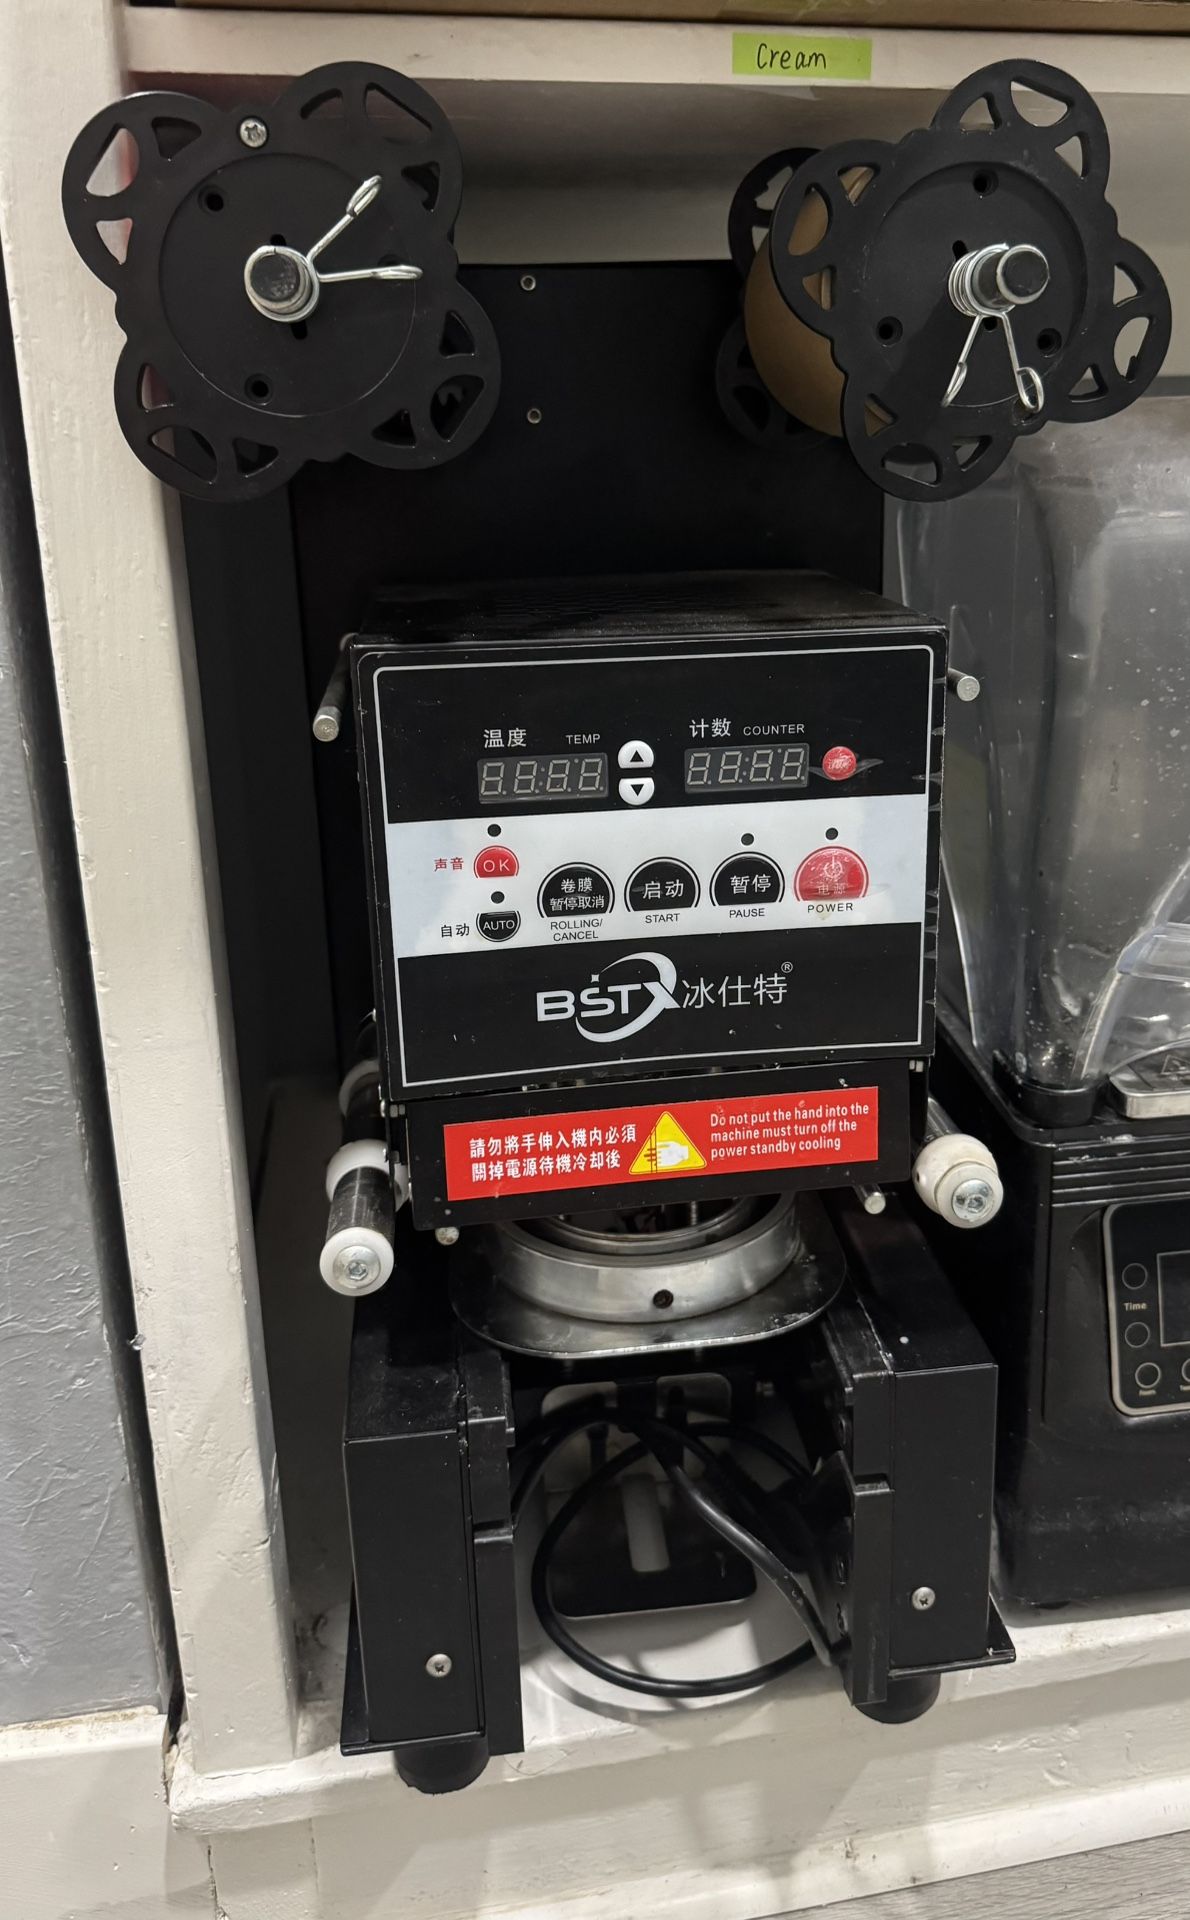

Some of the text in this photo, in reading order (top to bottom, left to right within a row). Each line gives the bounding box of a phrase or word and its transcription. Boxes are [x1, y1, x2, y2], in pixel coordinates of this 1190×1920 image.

[756, 42, 827, 70] Cream
[689, 717, 731, 738] 计数
[743, 723, 805, 736] COUNTER
[483, 727, 527, 748] 温度
[566, 733, 601, 745] TEMP
[434, 857, 464, 872] 声音
[483, 859, 510, 873] OK
[560, 877, 593, 894] 卷膜
[642, 879, 684, 900] 启动
[730, 874, 772, 894] 暂停
[550, 895, 605, 912] 暂停取消
[807, 902, 854, 913] POWER
[645, 913, 680, 924] START
[729, 908, 765, 919] PAUSE
[441, 923, 470, 938] 自动
[482, 919, 515, 931] AUTO
[550, 918, 603, 931] ROLLING/
[553, 931, 598, 942] CANCEL
[710, 1102, 869, 1127] Do not put the hand into the
[711, 1119, 857, 1142] machine must turn off the
[711, 1136, 841, 1161] power standby cooling
[1123, 1301, 1147, 1312] Time
